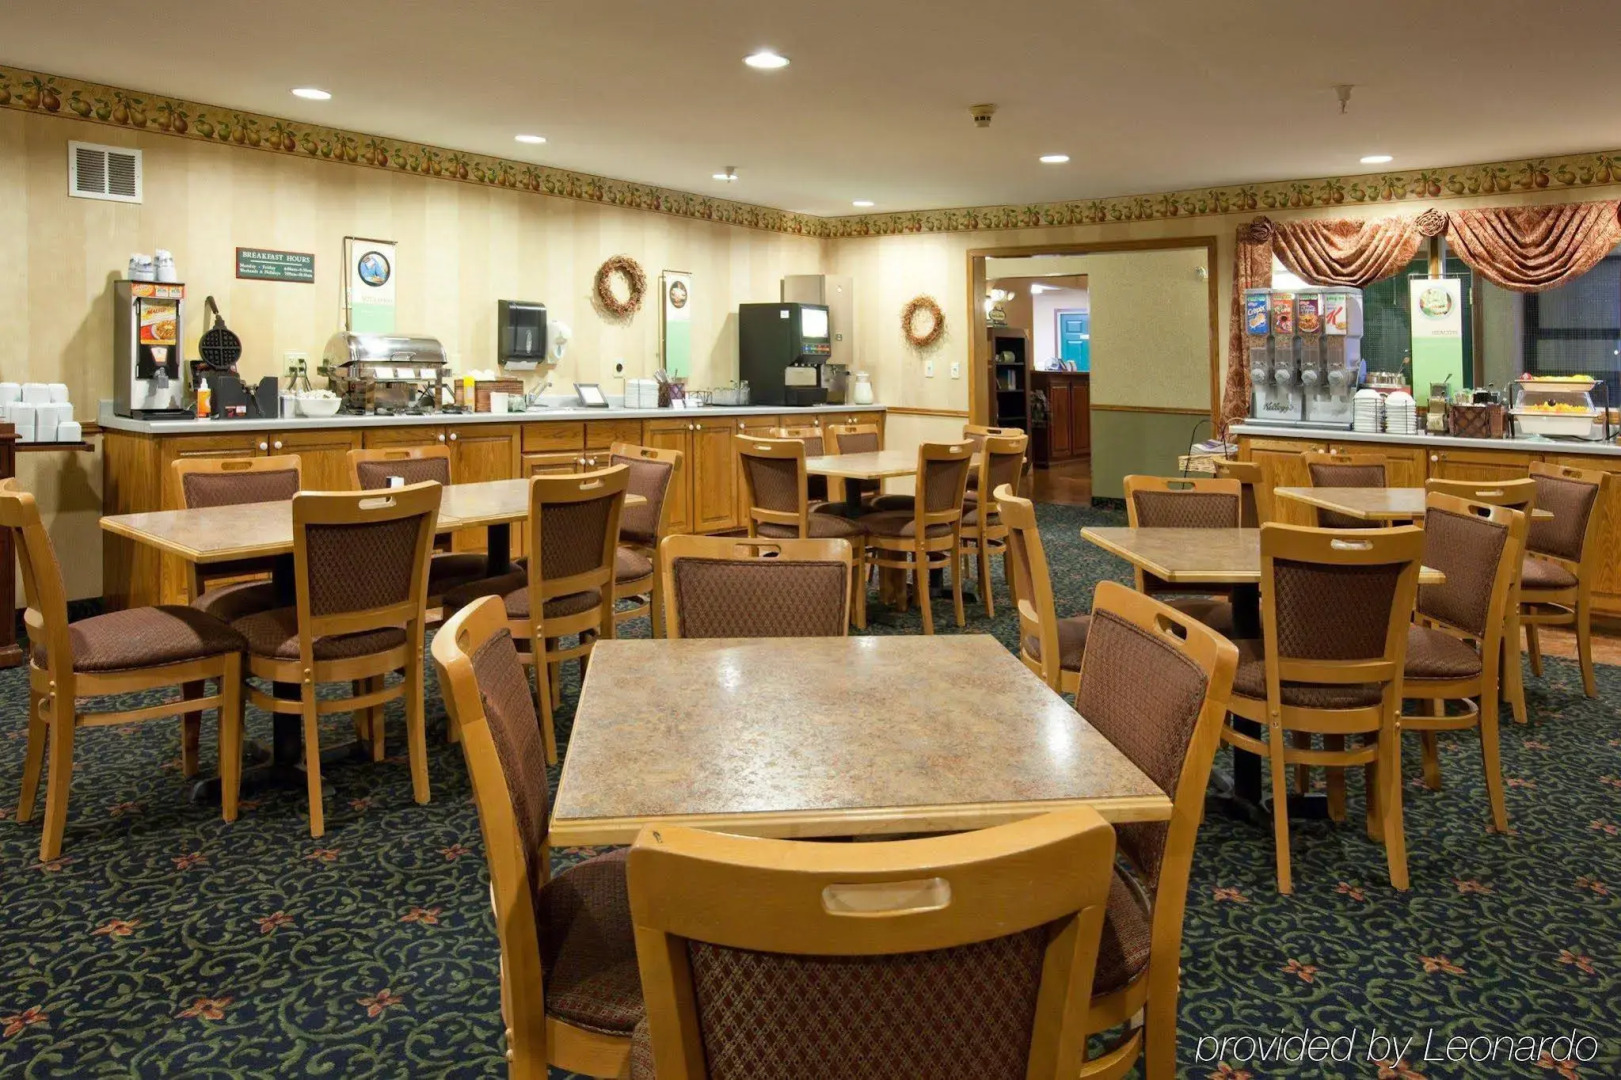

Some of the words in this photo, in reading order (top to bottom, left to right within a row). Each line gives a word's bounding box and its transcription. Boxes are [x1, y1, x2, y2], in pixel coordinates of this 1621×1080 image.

[243, 252, 283, 261] BREAKFAST
[1326, 306, 1343, 325] K
[1263, 402, 1294, 413] Kellogg's
